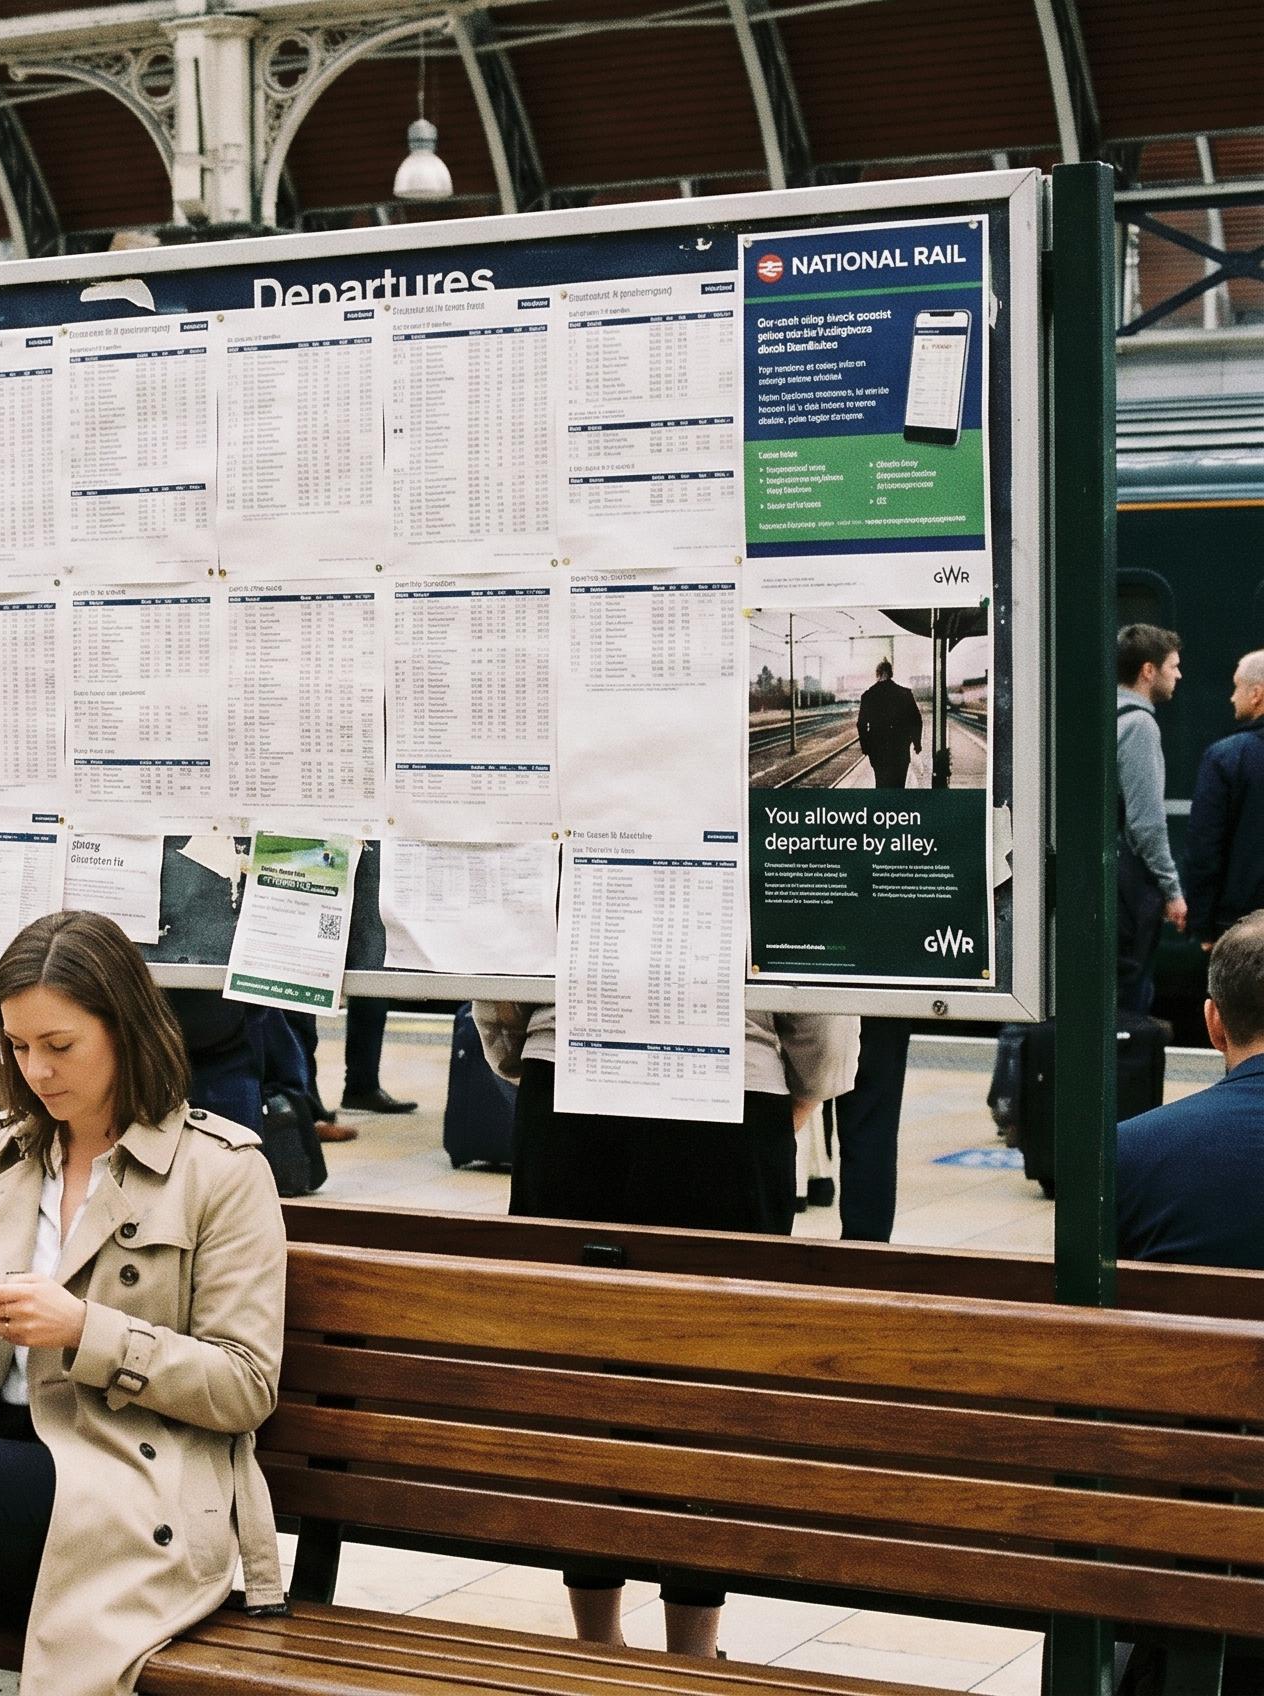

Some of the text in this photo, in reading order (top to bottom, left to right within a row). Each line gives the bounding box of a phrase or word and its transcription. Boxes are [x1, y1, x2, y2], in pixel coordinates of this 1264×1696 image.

[792, 244, 967, 276] NATIONAL RAIL
[253, 268, 495, 309] Departures
[933, 565, 970, 585] GWR
[764, 807, 921, 829] You allowd open
[764, 832, 938, 857] departure by alley.
[923, 925, 974, 959] GWR
